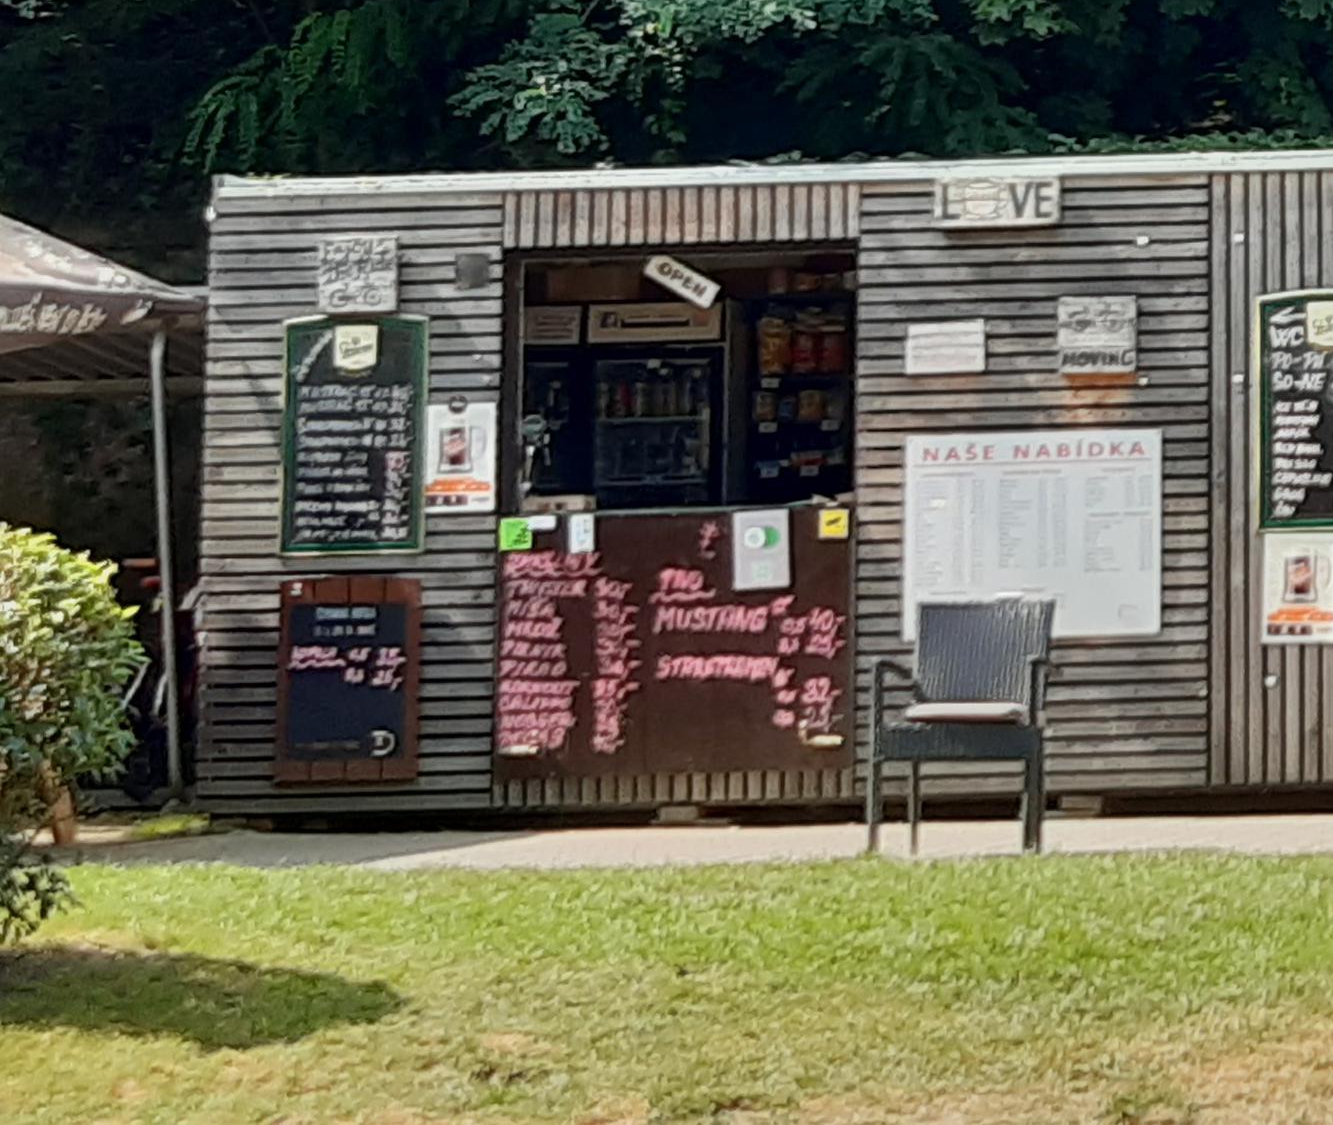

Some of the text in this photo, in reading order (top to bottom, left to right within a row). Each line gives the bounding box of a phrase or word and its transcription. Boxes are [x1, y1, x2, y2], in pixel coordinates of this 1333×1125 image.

[655, 259, 709, 300] OPEN
[1269, 325, 1304, 347] WC
[922, 439, 1147, 462] NAŠE NABÍDKA
[652, 604, 769, 635] MUSTANG
